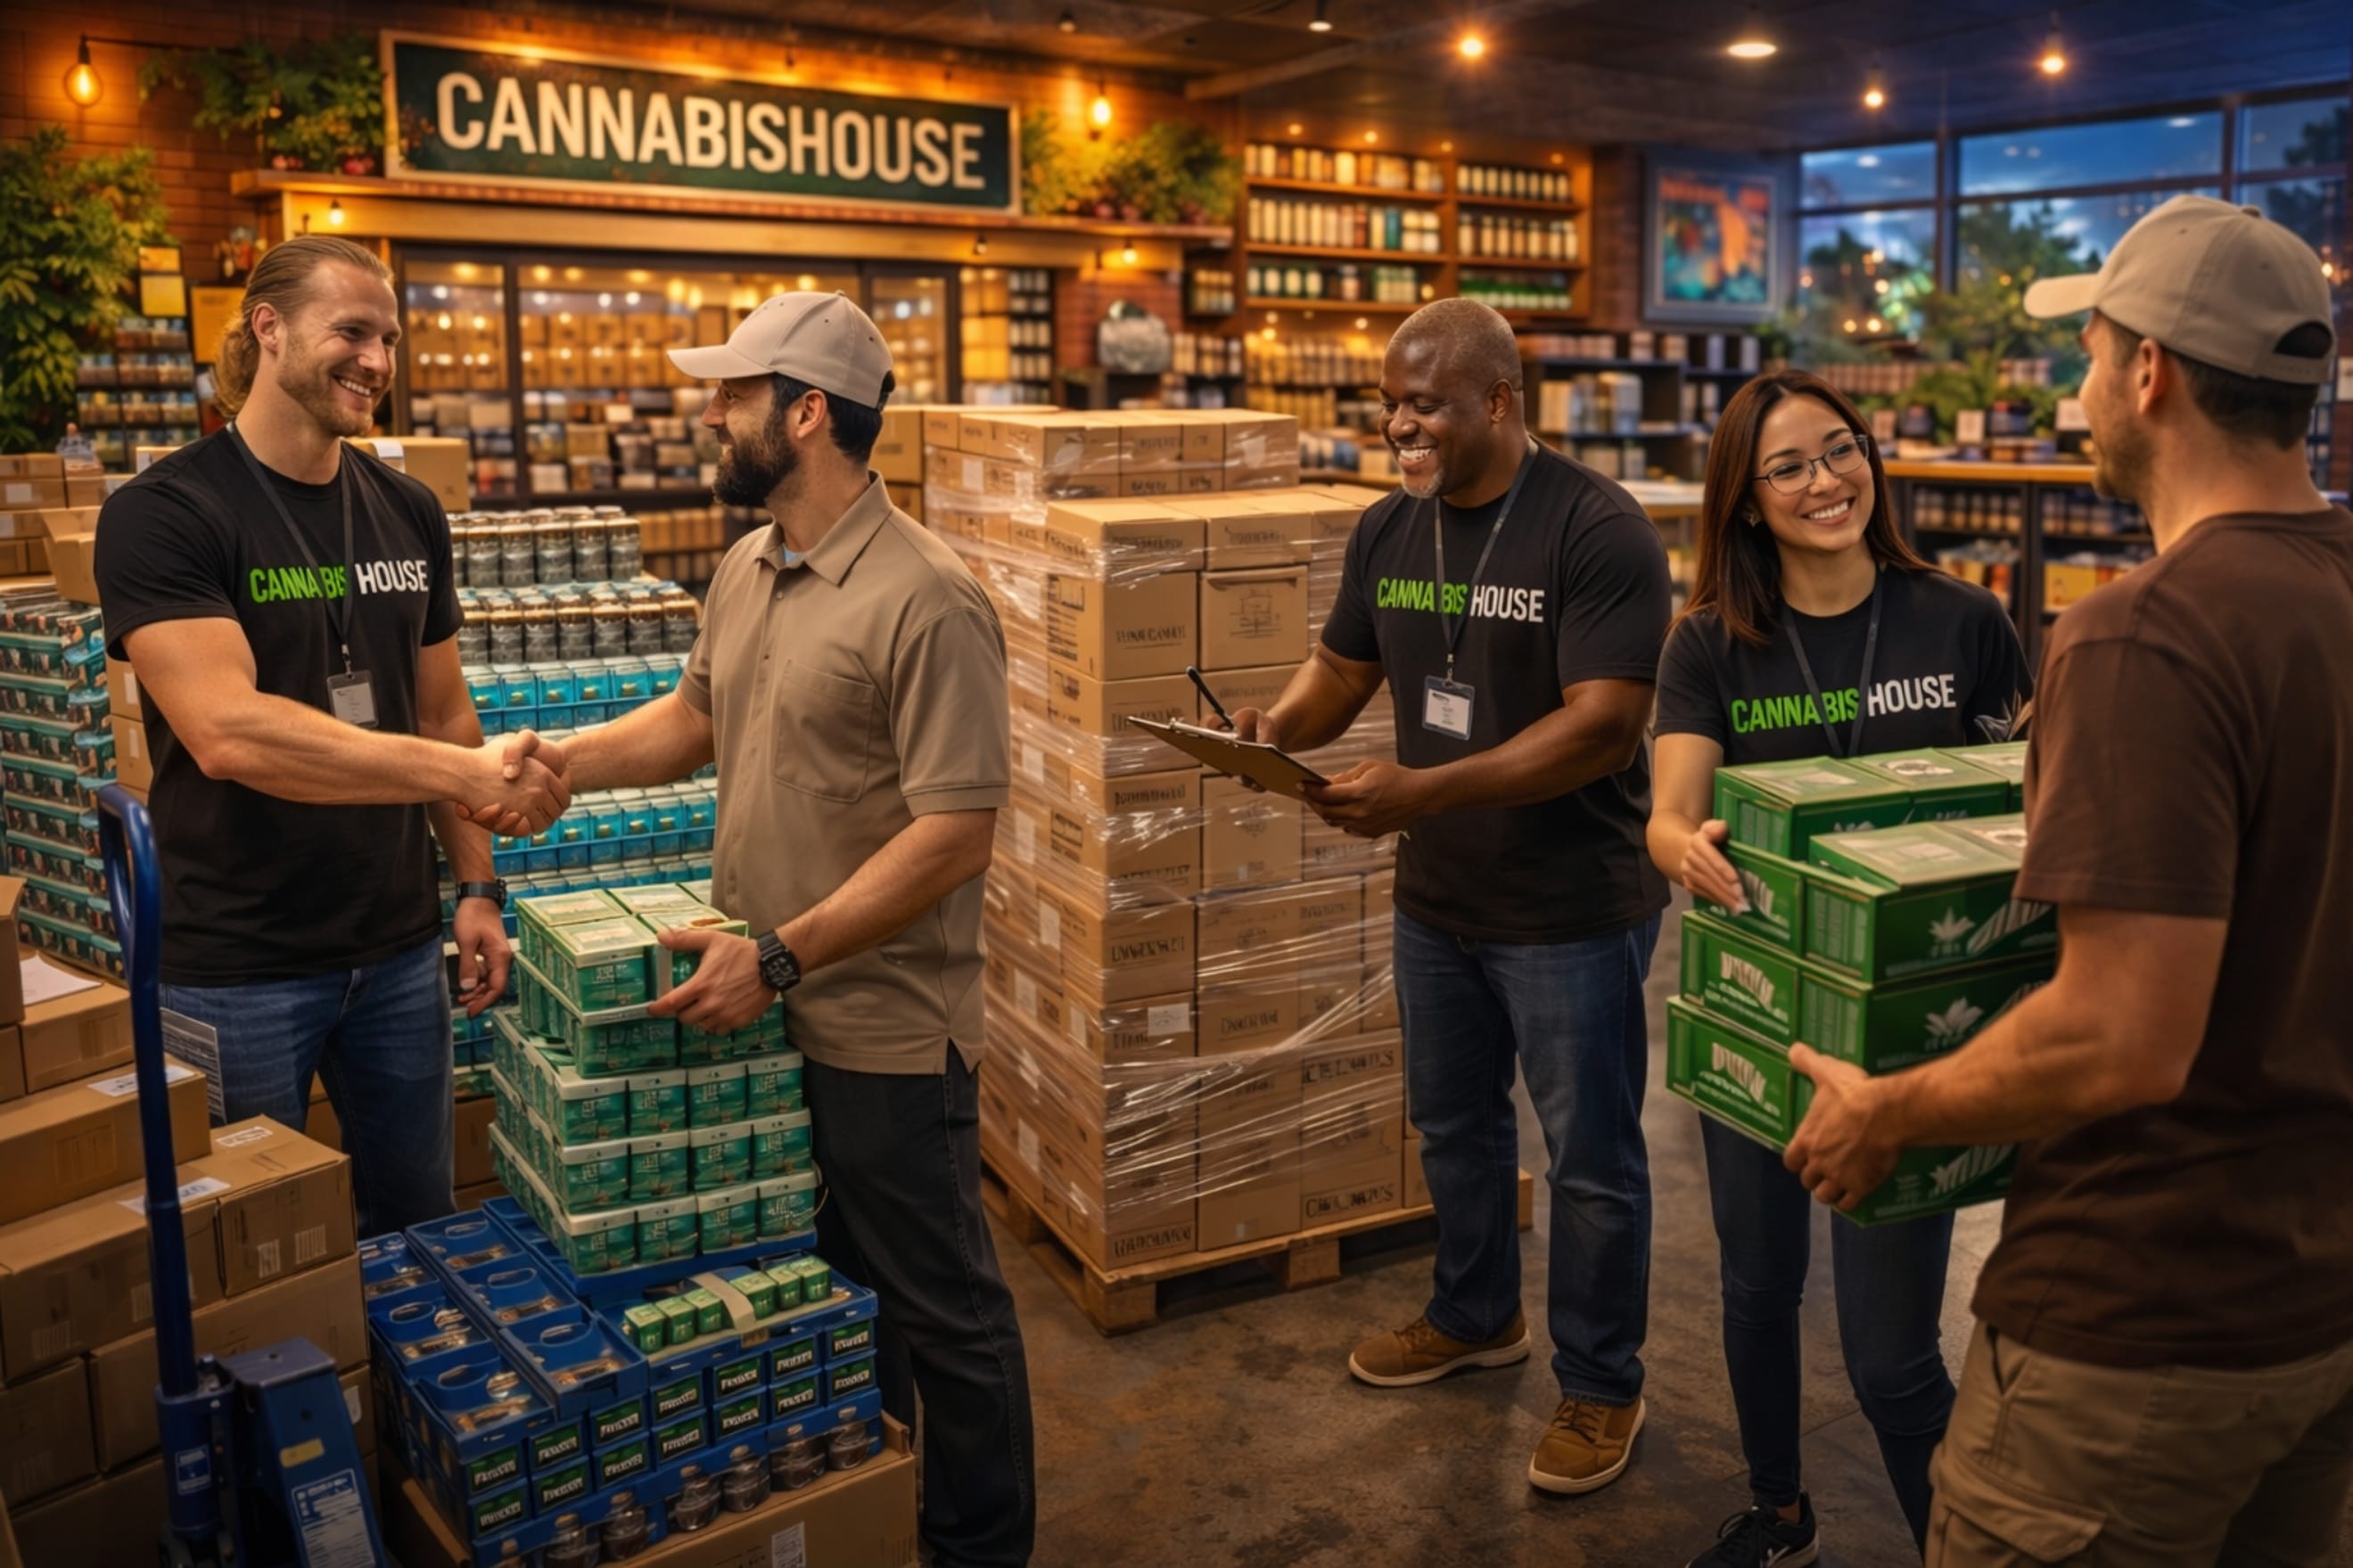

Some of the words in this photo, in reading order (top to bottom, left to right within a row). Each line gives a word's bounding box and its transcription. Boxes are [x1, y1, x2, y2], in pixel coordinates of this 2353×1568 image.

[436, 71, 986, 190] CANNABISHOUSE
[355, 559, 429, 595] HOUSE
[1470, 584, 1545, 623] HOUSE
[1731, 686, 1861, 734] CANNABIS
[1867, 673, 1957, 718] HOUSE
